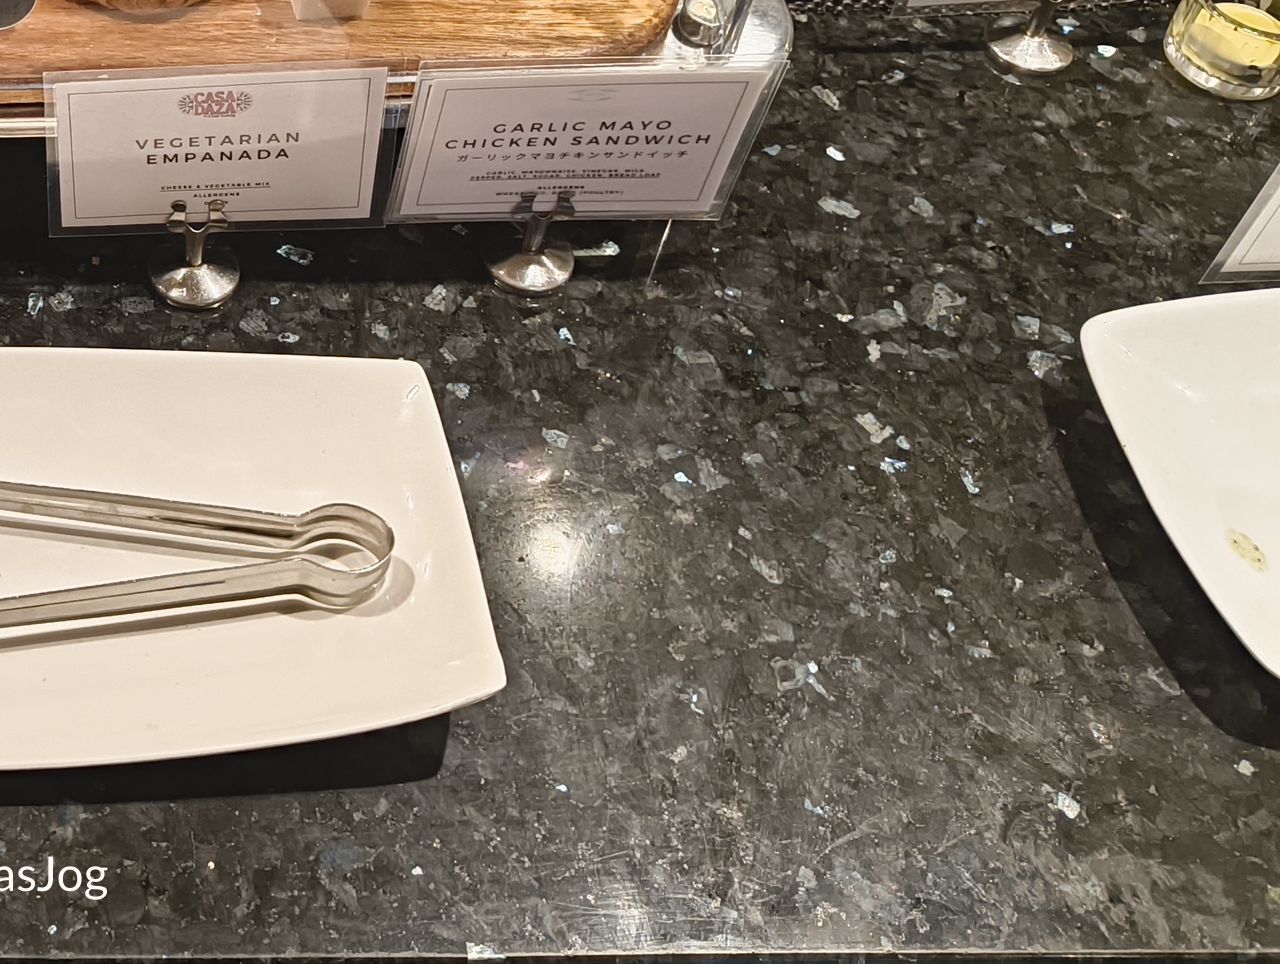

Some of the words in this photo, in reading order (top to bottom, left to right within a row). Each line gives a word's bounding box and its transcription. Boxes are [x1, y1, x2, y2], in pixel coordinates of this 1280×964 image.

[193, 90, 236, 104] CASA
[194, 102, 237, 116] DAZA
[493, 121, 587, 134] GARLIC
[599, 120, 672, 131] MAYO
[135, 132, 300, 150] VEGETARIAN
[445, 136, 559, 150] CHICKEN
[570, 134, 711, 146] SANDWICH
[146, 148, 290, 165] EMPANADA
